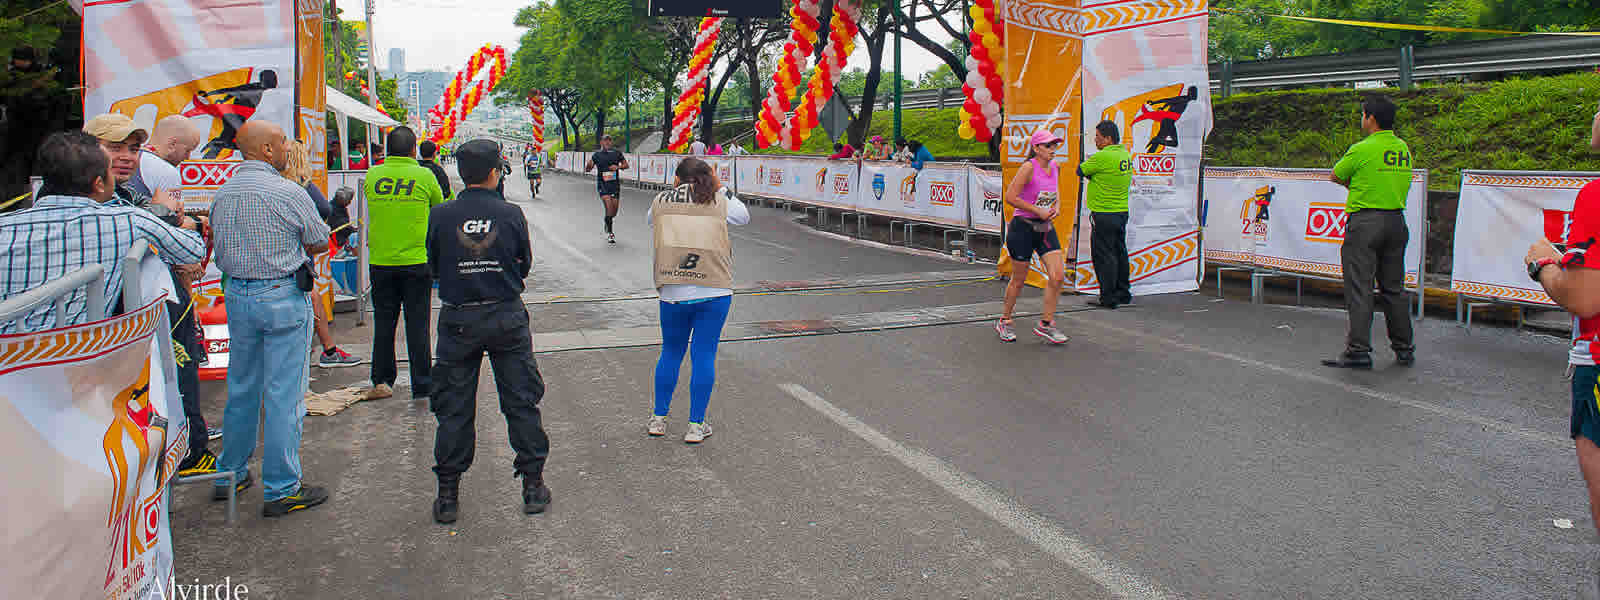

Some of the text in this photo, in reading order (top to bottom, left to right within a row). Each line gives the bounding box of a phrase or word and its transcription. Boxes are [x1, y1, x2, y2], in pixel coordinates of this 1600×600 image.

[1139, 157, 1174, 172] OXXO
[1384, 150, 1410, 167] GH
[375, 177, 416, 196] GH
[930, 184, 953, 201] OXXO
[464, 219, 492, 233] GH
